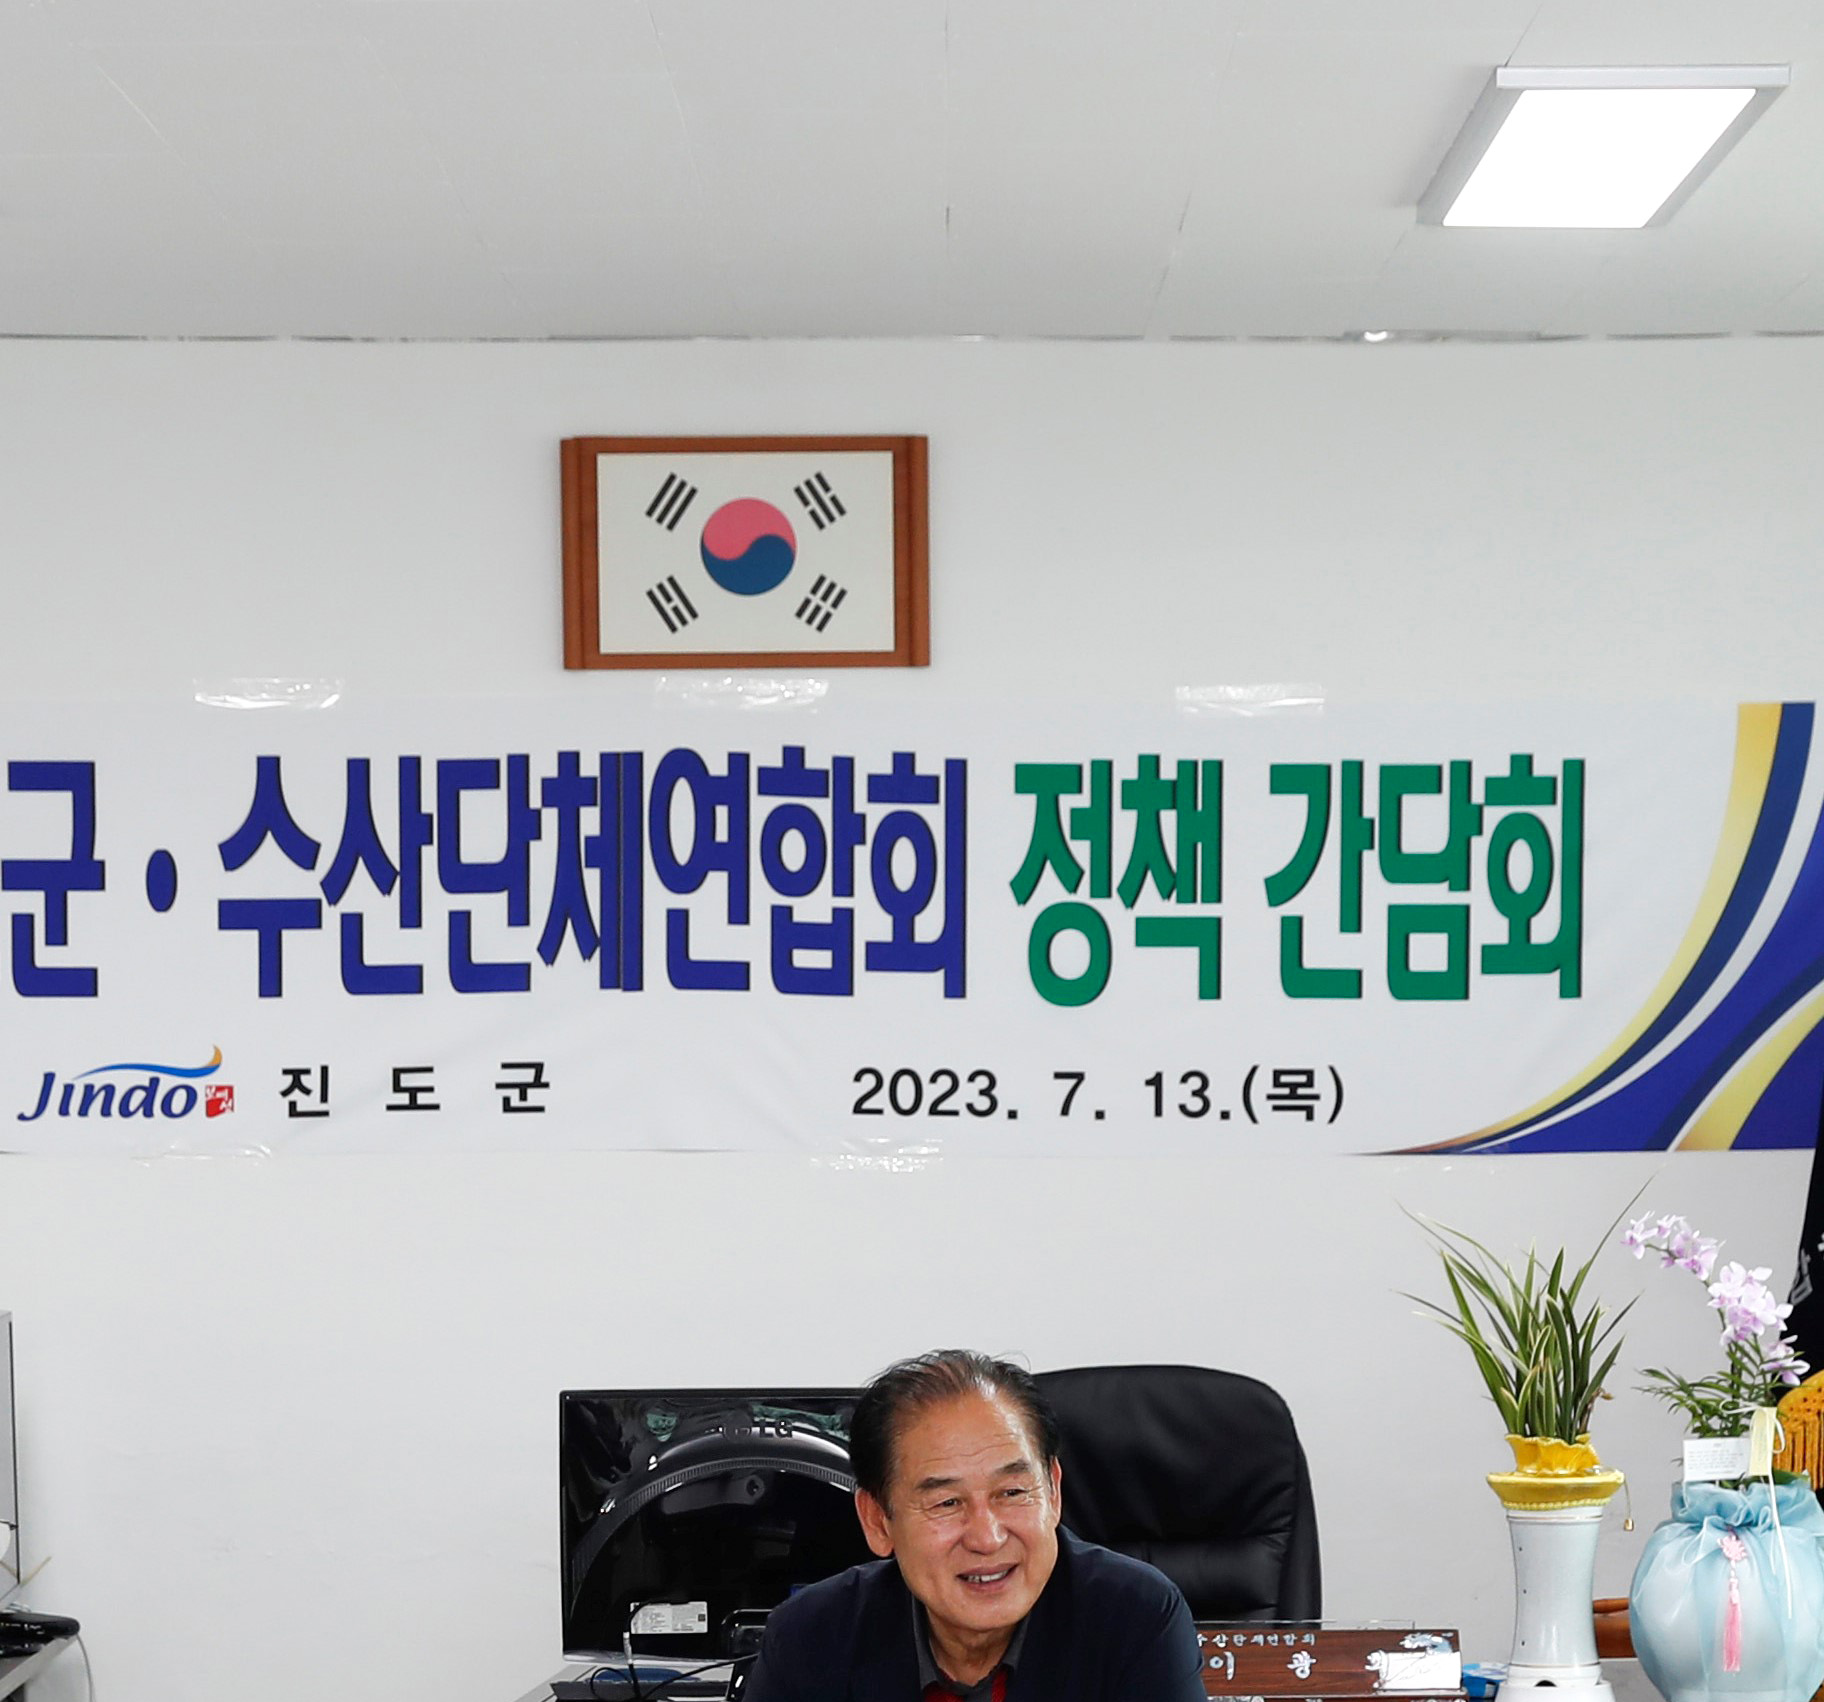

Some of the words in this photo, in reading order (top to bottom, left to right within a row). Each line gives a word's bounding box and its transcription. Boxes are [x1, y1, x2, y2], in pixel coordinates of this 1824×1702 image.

[217, 746, 967, 999] 수산단체연합회
[1009, 754, 1224, 1007] 정책
[1264, 754, 1586, 1001] 간담회
[17, 1072, 198, 1122] Jindo
